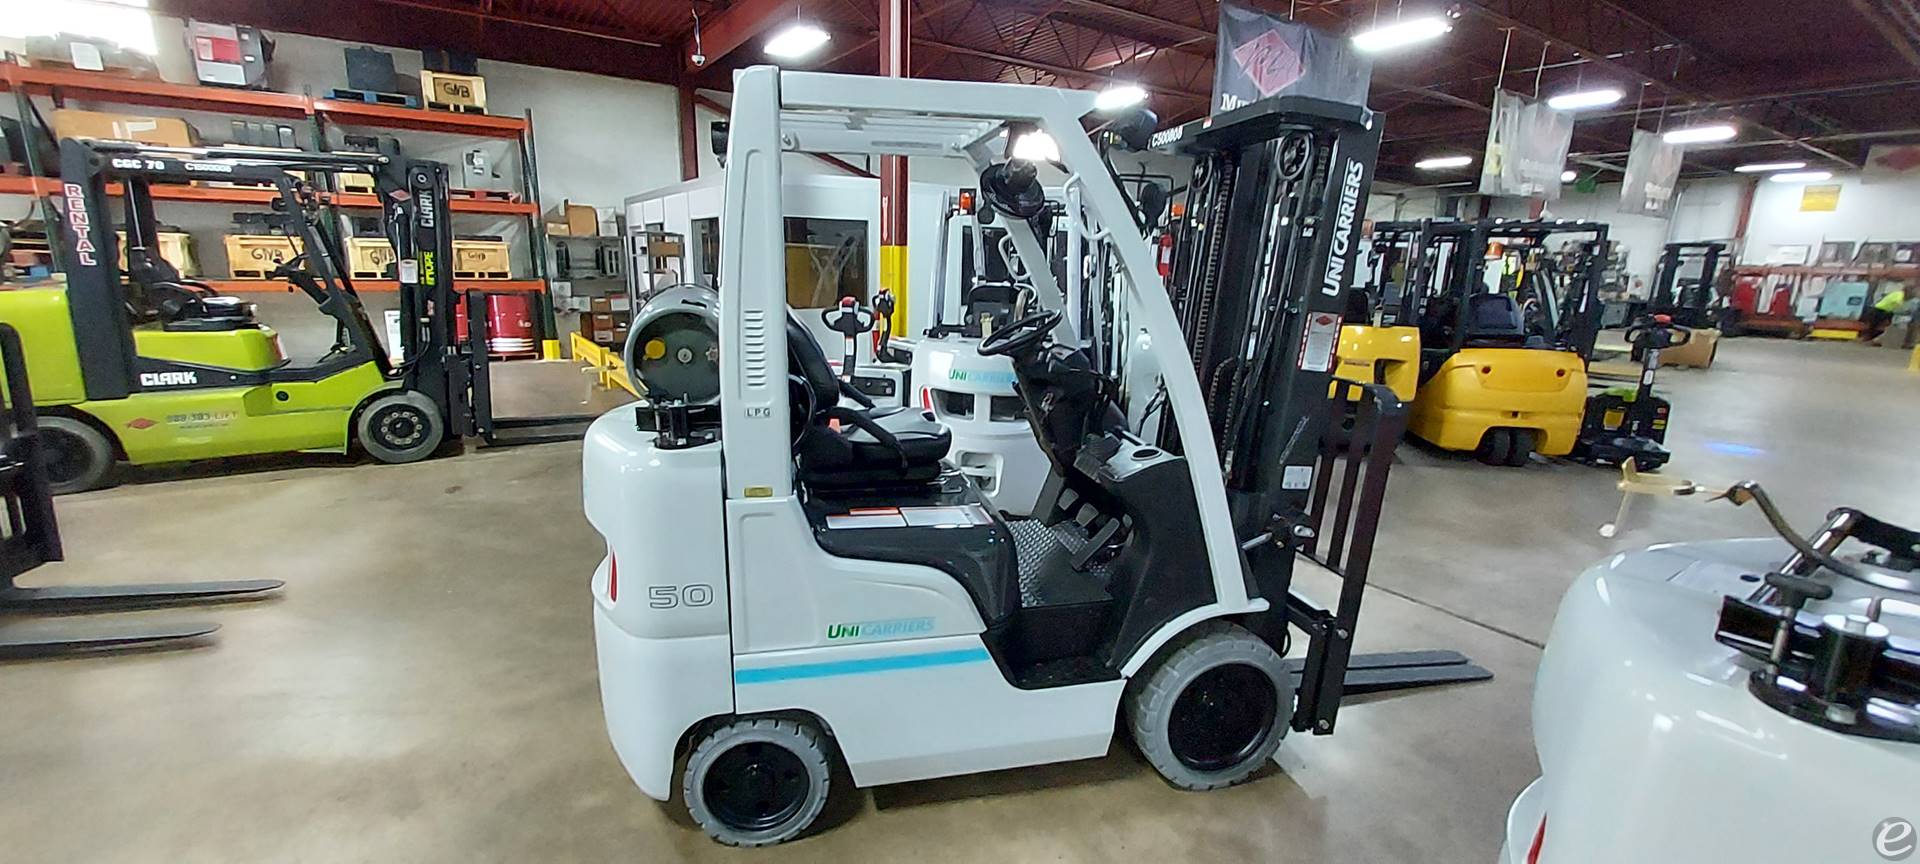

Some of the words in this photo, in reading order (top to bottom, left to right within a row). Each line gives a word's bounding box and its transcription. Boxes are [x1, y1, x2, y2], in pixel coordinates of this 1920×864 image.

[419, 189, 434, 228] CLARK
[64, 183, 97, 266] RENTAL
[139, 371, 198, 387] CLARK
[746, 407, 771, 418] LPG
[648, 583, 714, 609] 50
